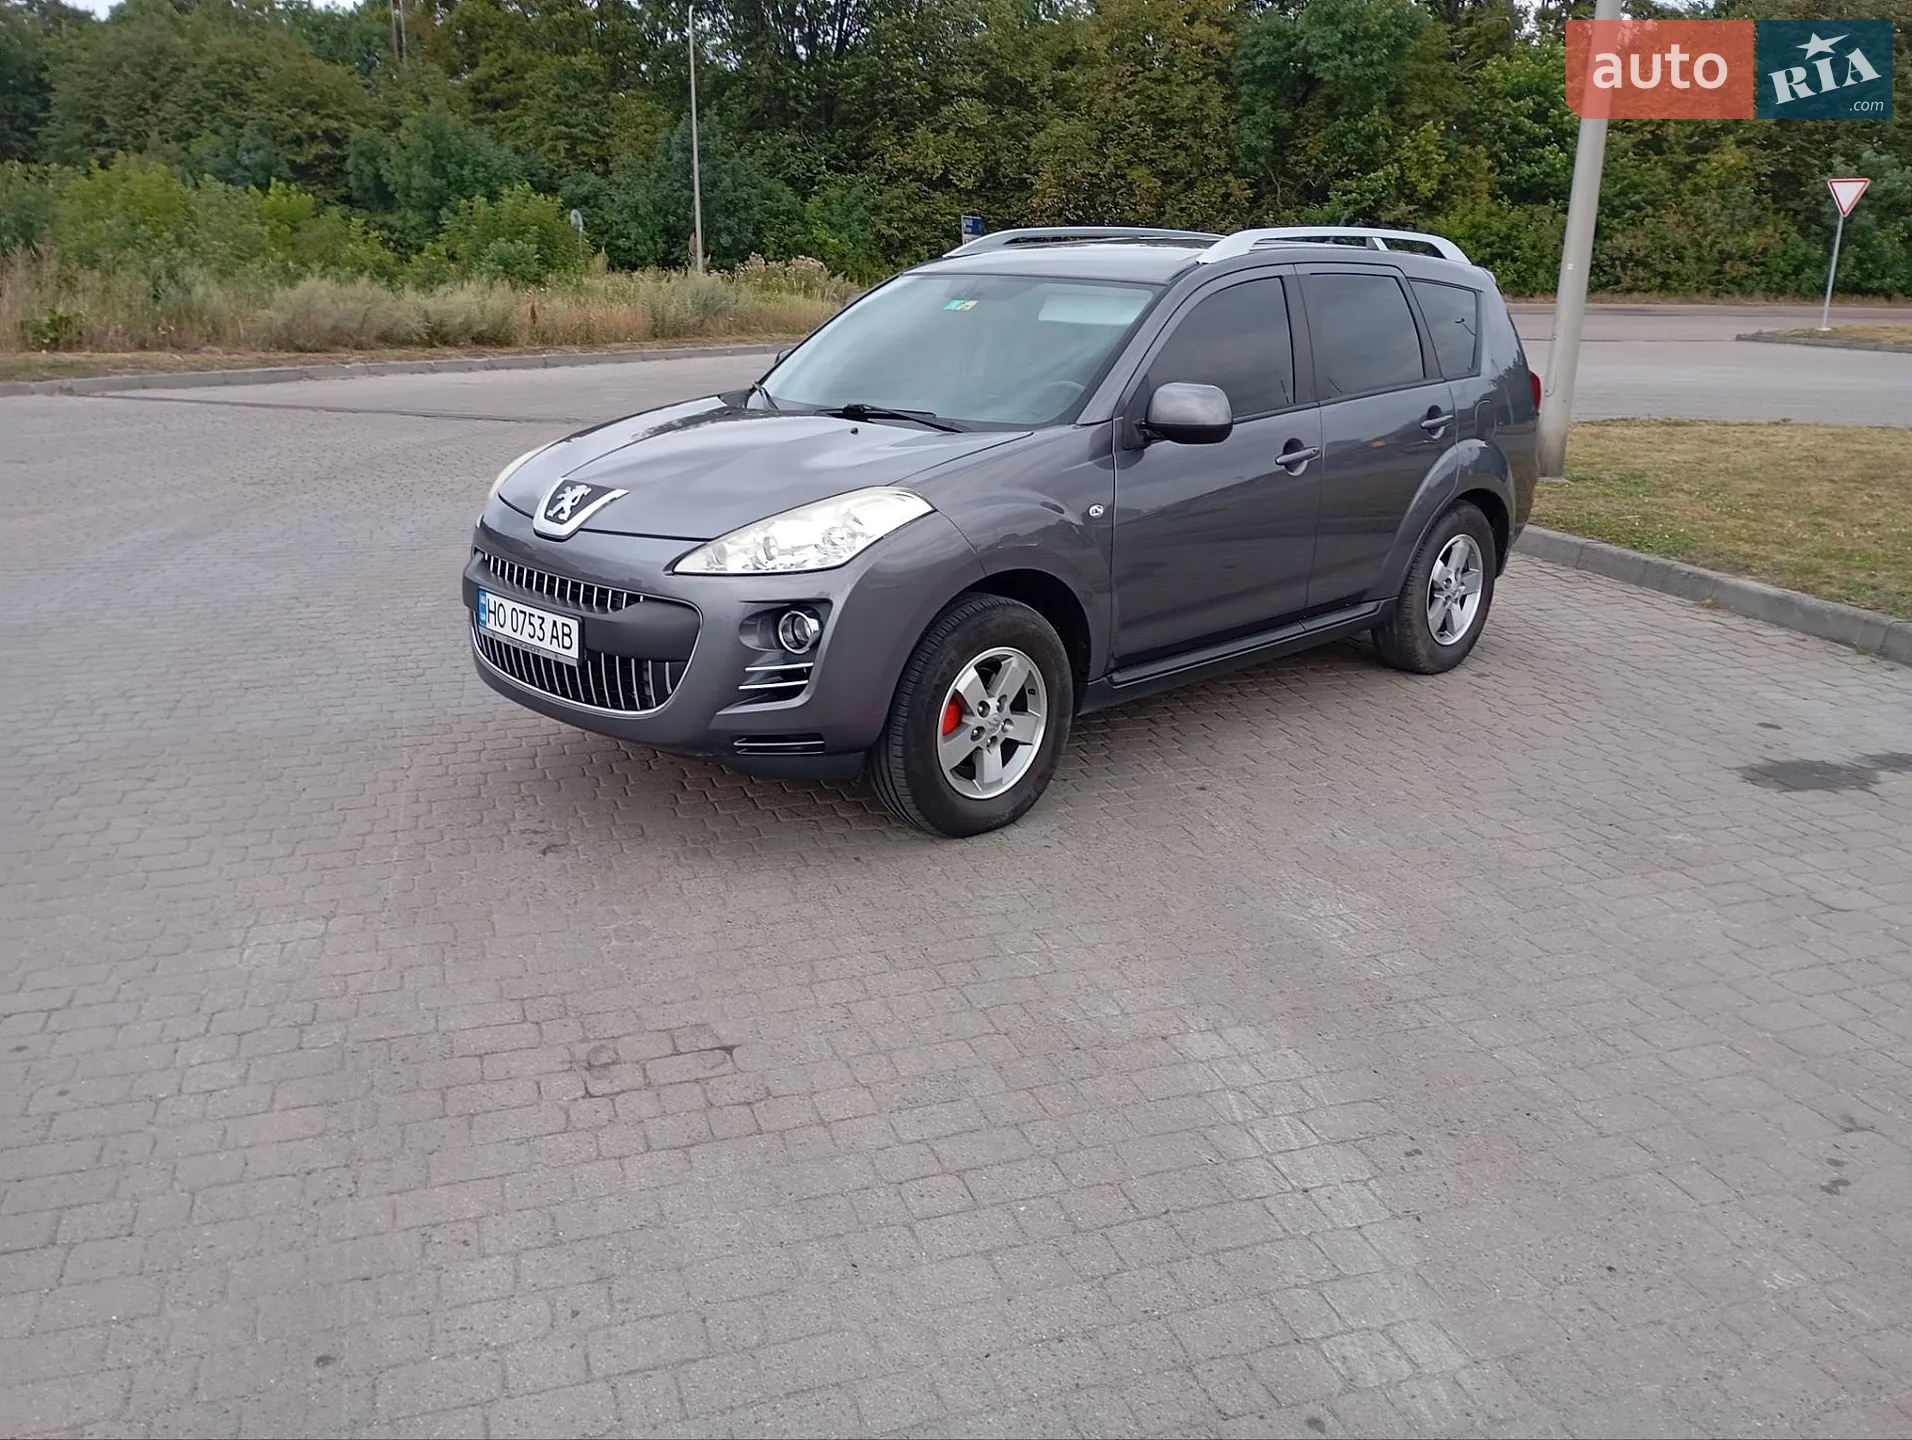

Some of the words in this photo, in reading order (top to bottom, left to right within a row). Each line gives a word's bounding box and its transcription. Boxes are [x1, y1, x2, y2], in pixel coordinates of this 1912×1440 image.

[487, 598, 506, 628] HO
[511, 607, 546, 642] 0753
[550, 620, 573, 651] AB
